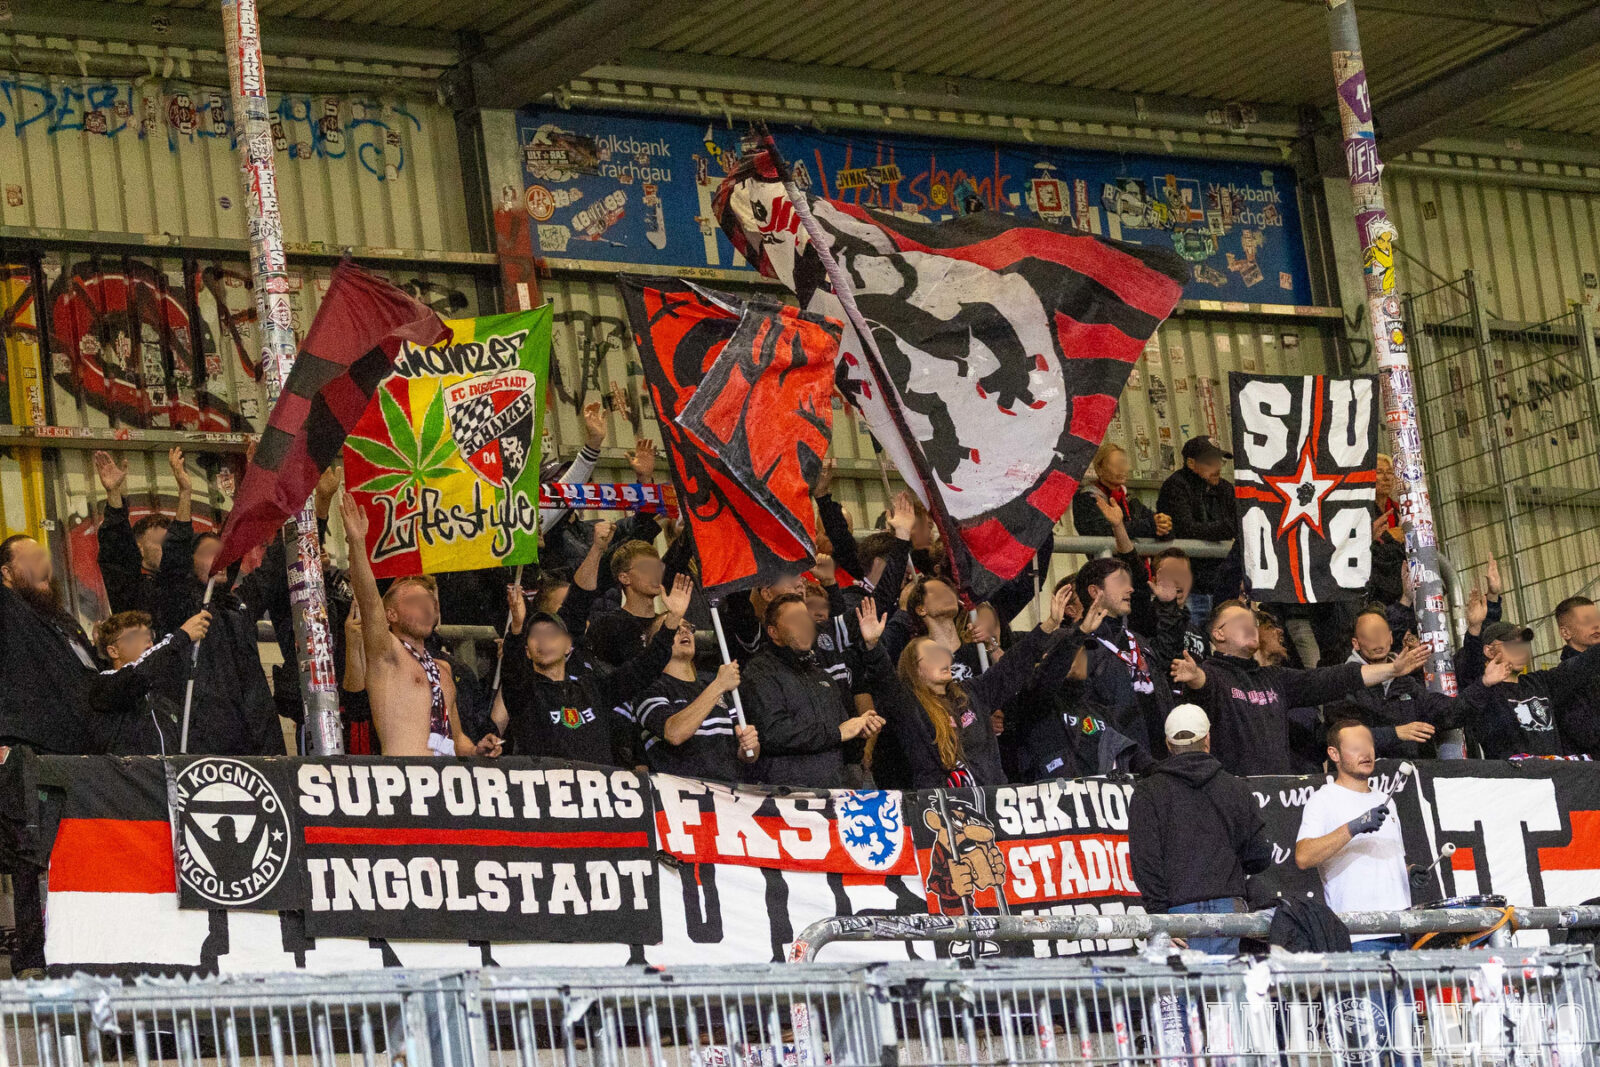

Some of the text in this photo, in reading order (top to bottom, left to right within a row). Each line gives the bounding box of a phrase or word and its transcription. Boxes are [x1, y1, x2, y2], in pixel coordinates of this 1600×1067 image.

[595, 134, 671, 157] olksbank
[463, 393, 533, 455] SCHANZER
[482, 452, 497, 464] 04
[372, 479, 535, 558] Lifestyle
[189, 764, 278, 814] KOGNITO
[298, 764, 645, 819] SUPPORTERS
[651, 773, 831, 860] FKS
[179, 845, 282, 898] INGOLSTADT
[307, 857, 652, 915] INGOLSTADT
